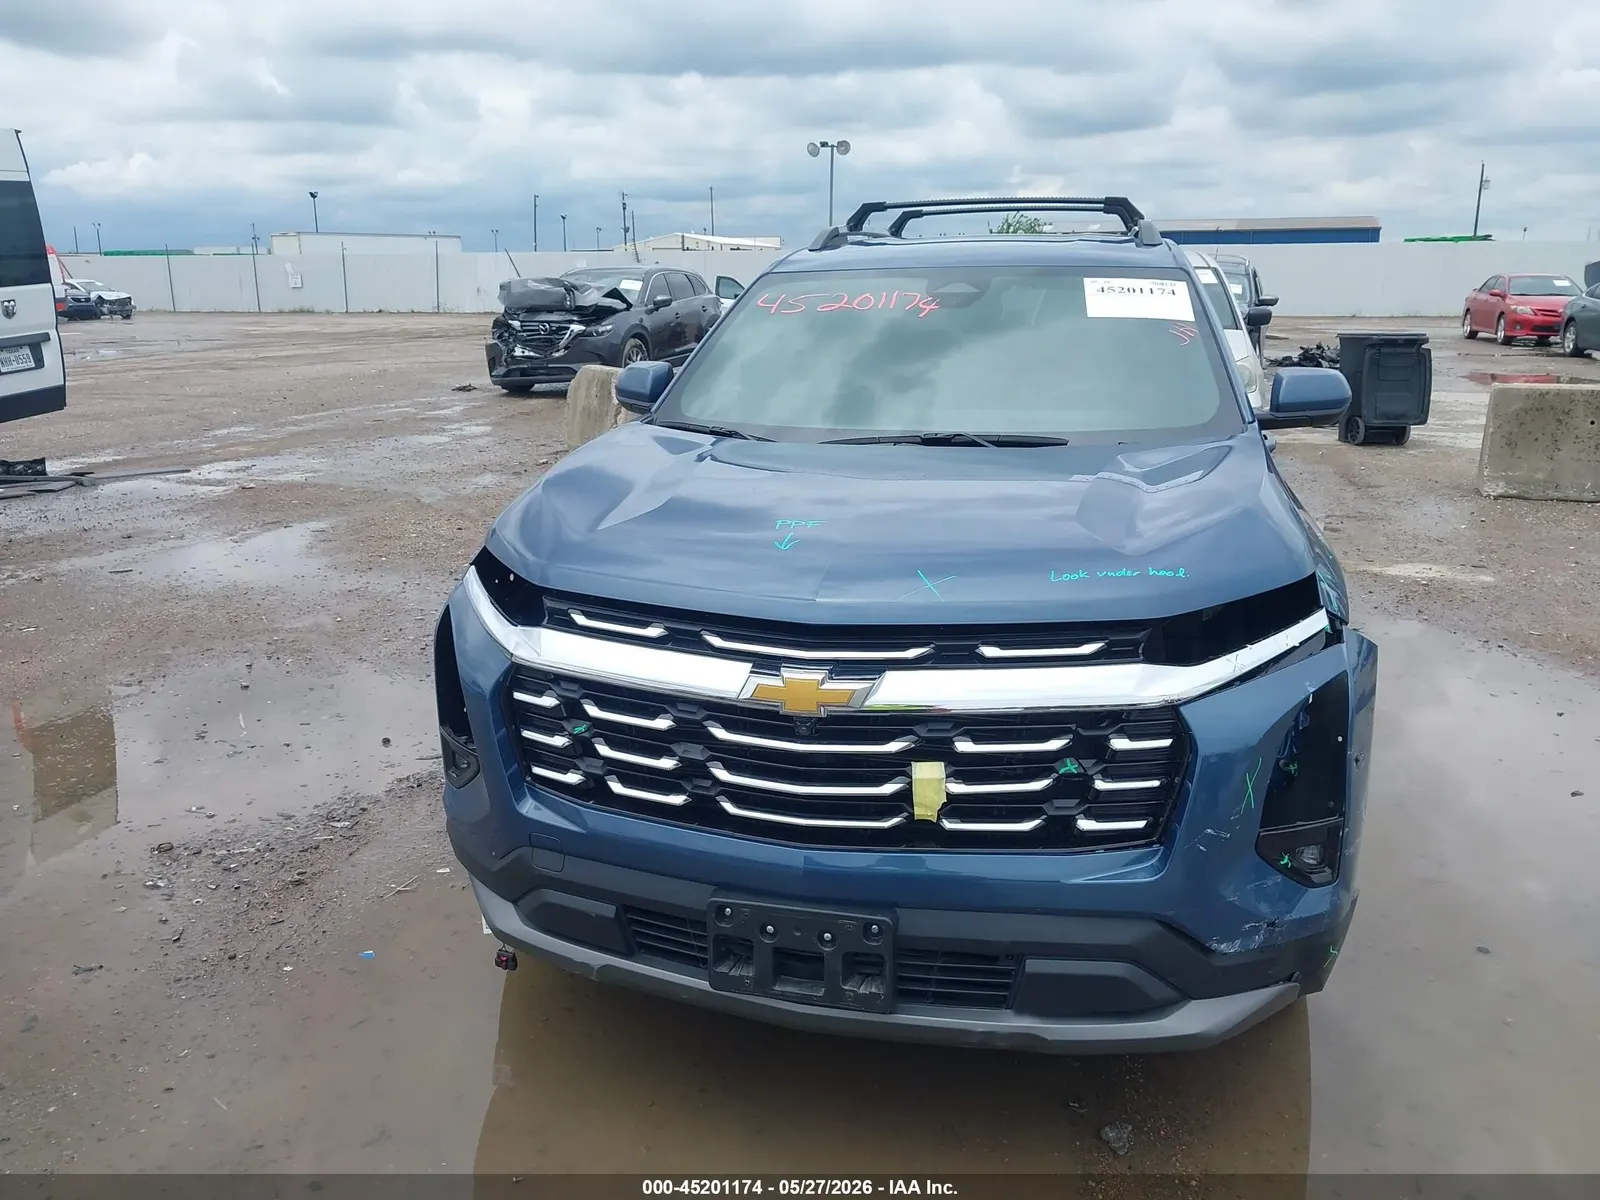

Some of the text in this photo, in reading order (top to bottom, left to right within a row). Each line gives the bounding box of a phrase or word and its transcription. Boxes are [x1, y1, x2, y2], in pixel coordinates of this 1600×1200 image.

[1096, 286, 1177, 296] 45201174
[757, 290, 941, 318] 45201174
[1050, 569, 1091, 582] Look
